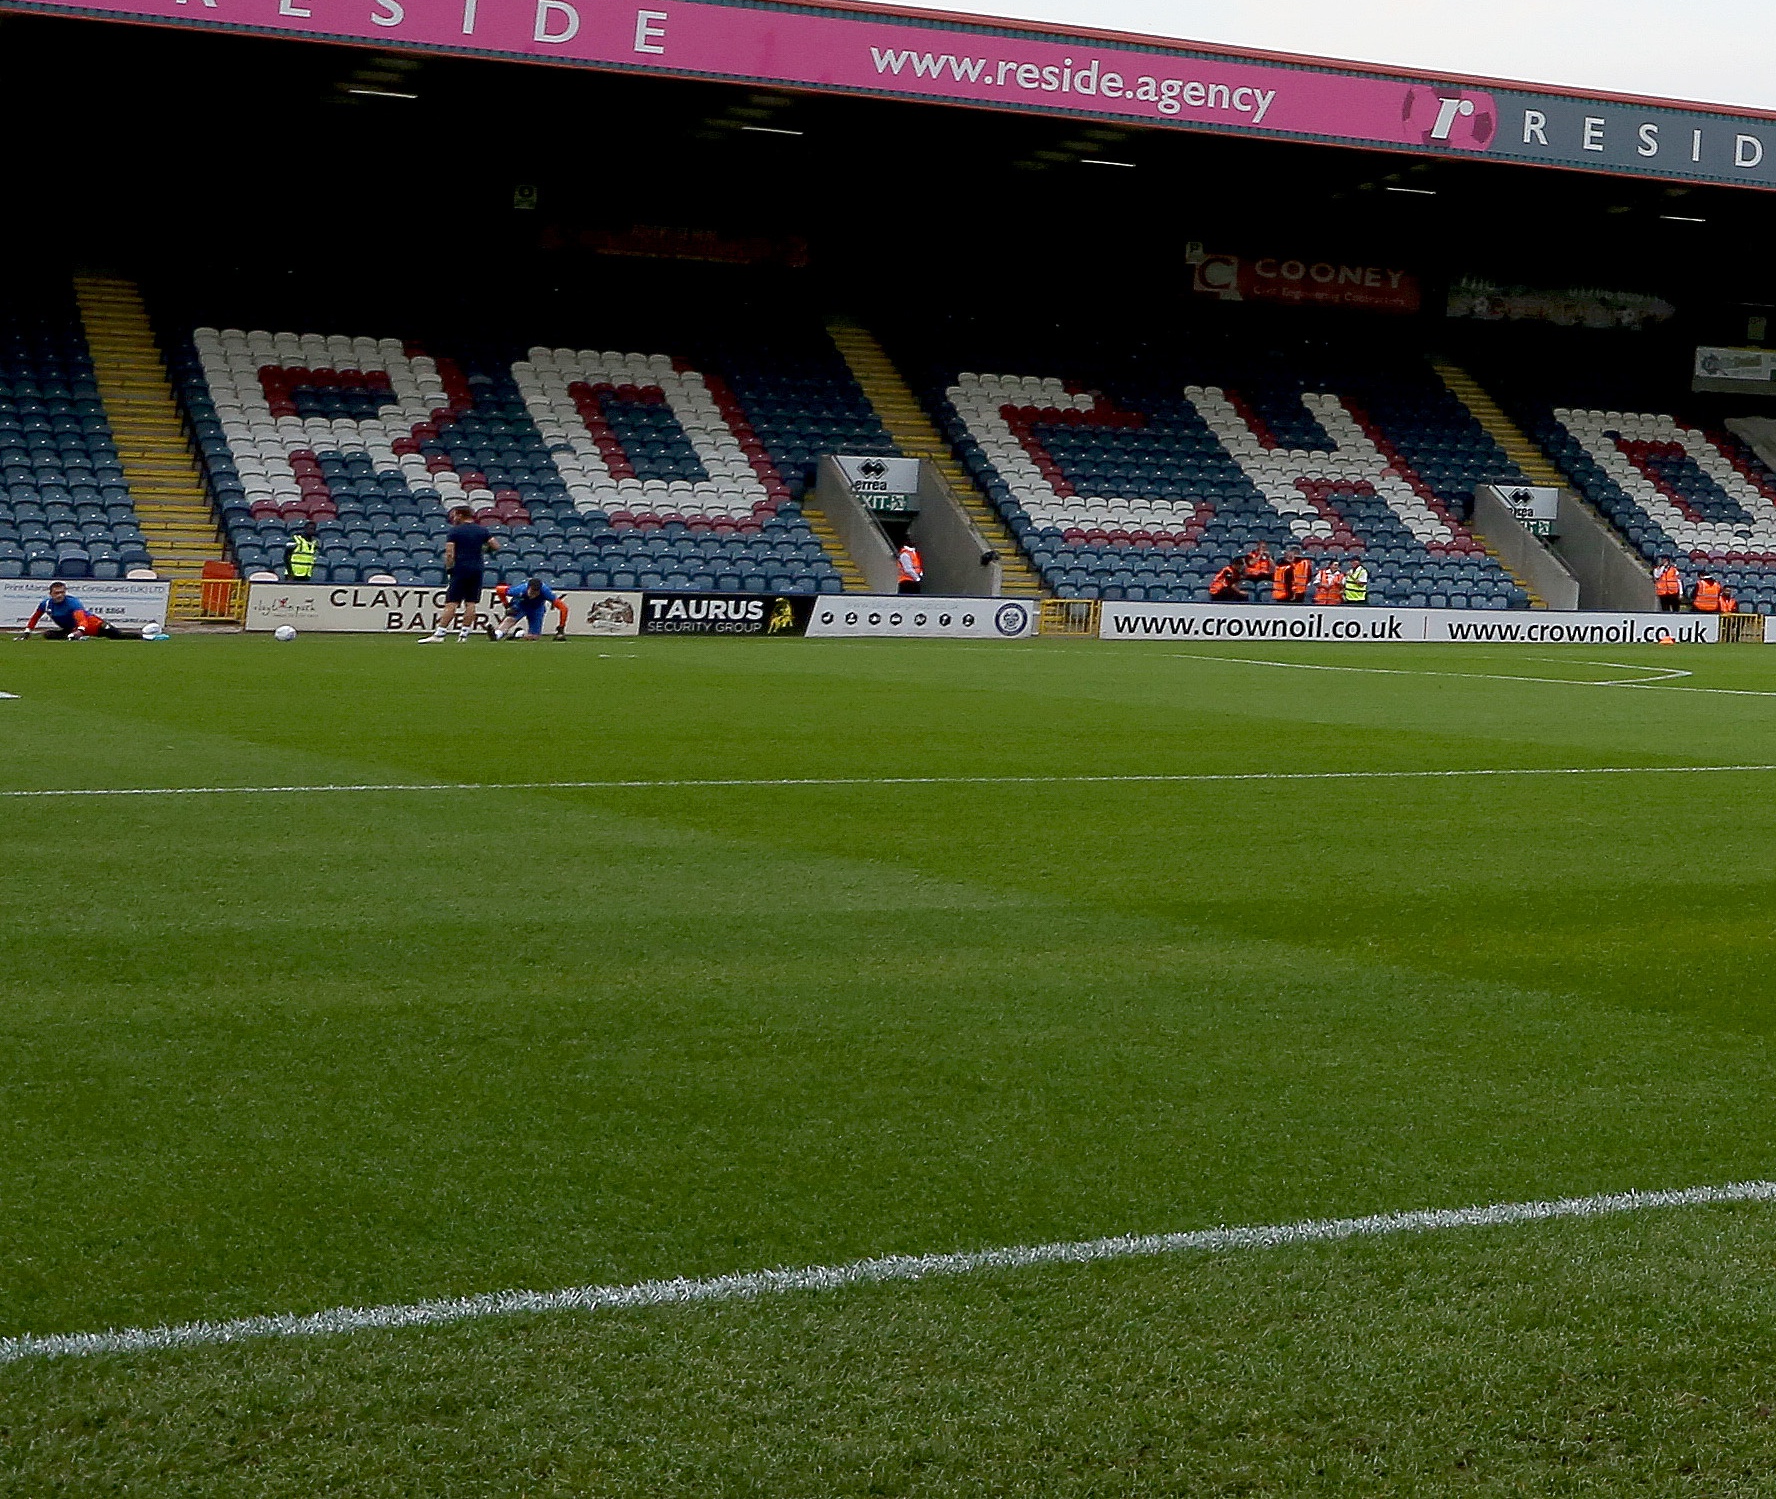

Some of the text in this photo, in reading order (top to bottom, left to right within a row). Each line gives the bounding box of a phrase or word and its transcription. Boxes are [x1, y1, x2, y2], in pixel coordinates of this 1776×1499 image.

[870, 45, 1276, 123] www.reside.agency
[1254, 258, 1405, 289] COONEY
[857, 494, 888, 510] XIT
[330, 589, 462, 609] CLAYTO
[650, 599, 764, 620] TAURUS
[648, 621, 763, 633] SECURITY GROUP
[1114, 613, 1402, 639] www.crownoil.co.uk
[1448, 619, 1708, 643] www.crownoil.co.uk
